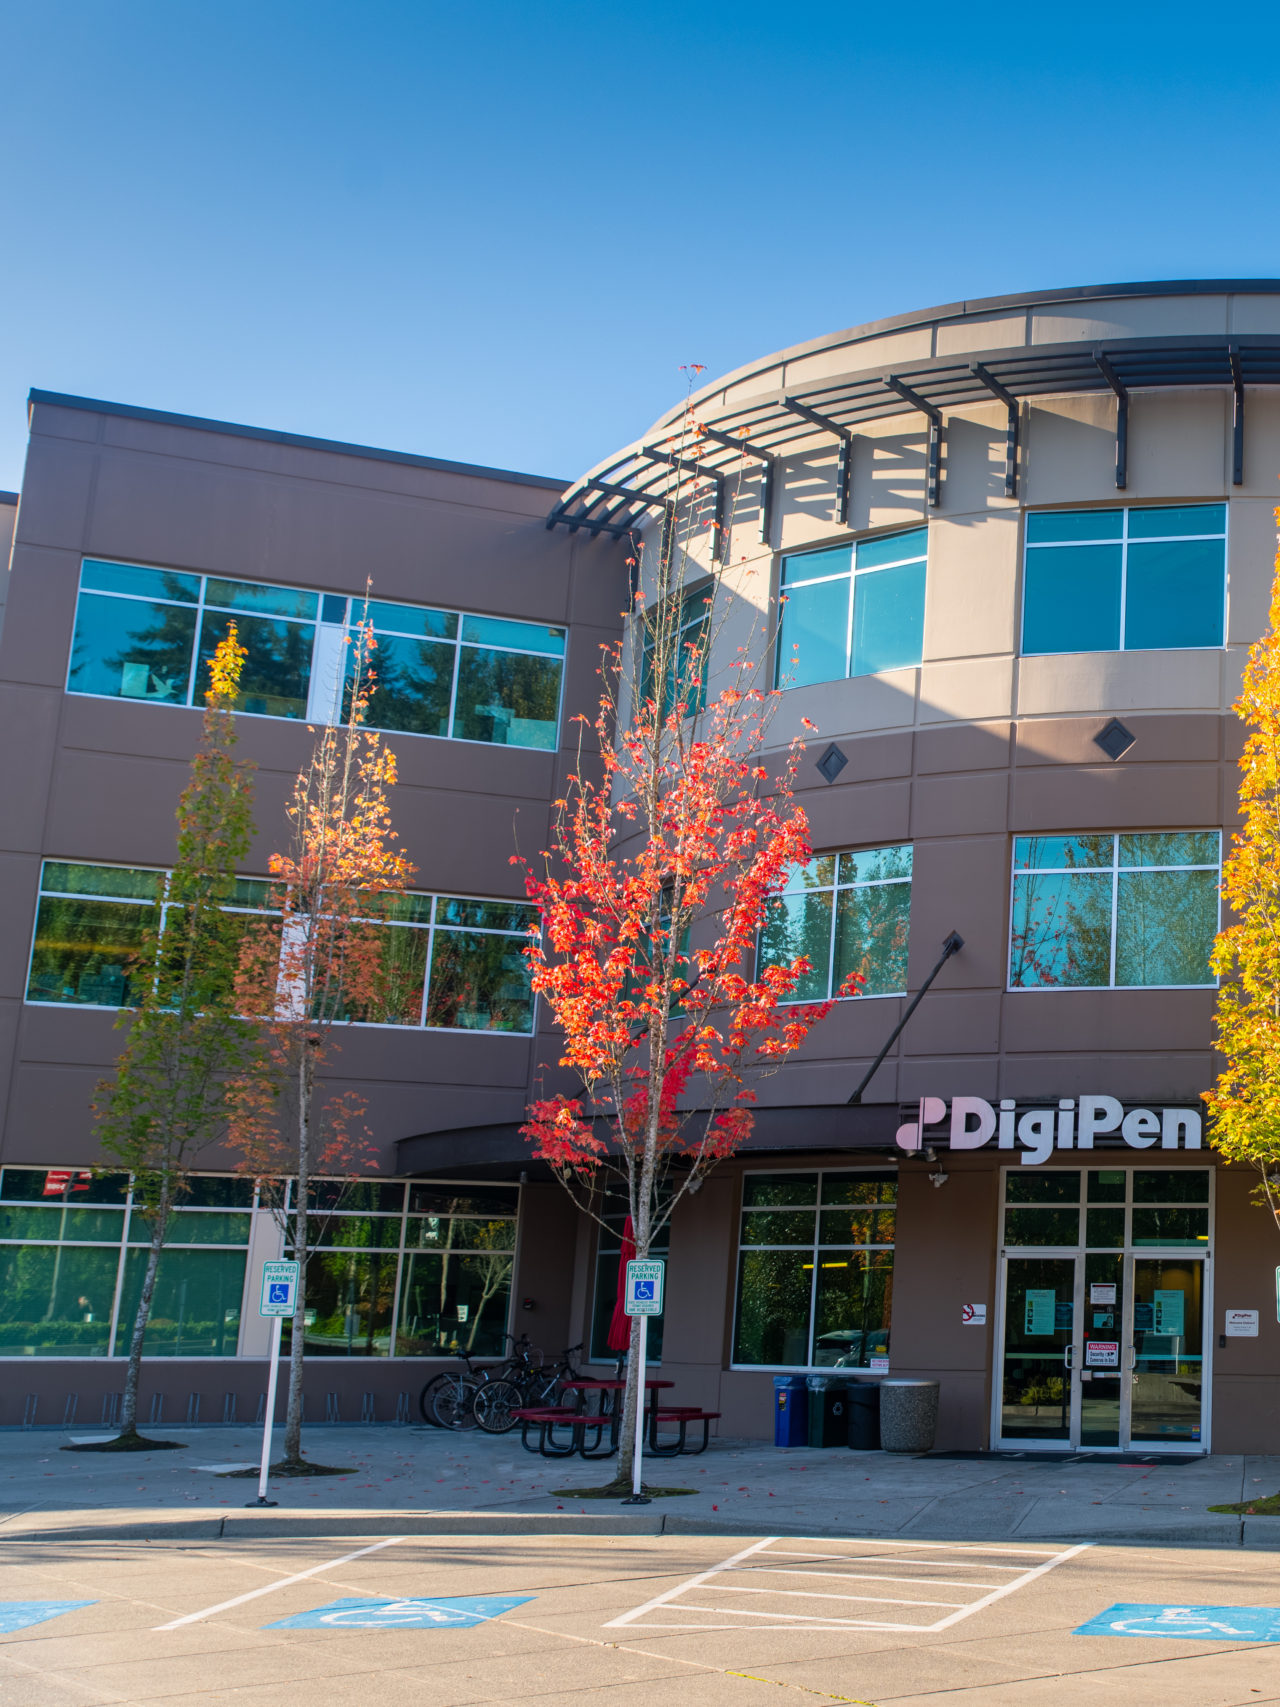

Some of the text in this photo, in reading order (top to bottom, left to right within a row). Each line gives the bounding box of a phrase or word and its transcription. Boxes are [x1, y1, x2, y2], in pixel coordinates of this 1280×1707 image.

[950, 1095, 1202, 1165] DigiPen
[265, 1265, 296, 1273] RESERVED
[630, 1264, 661, 1272] RESERVED
[631, 1272, 659, 1280] PARKING
